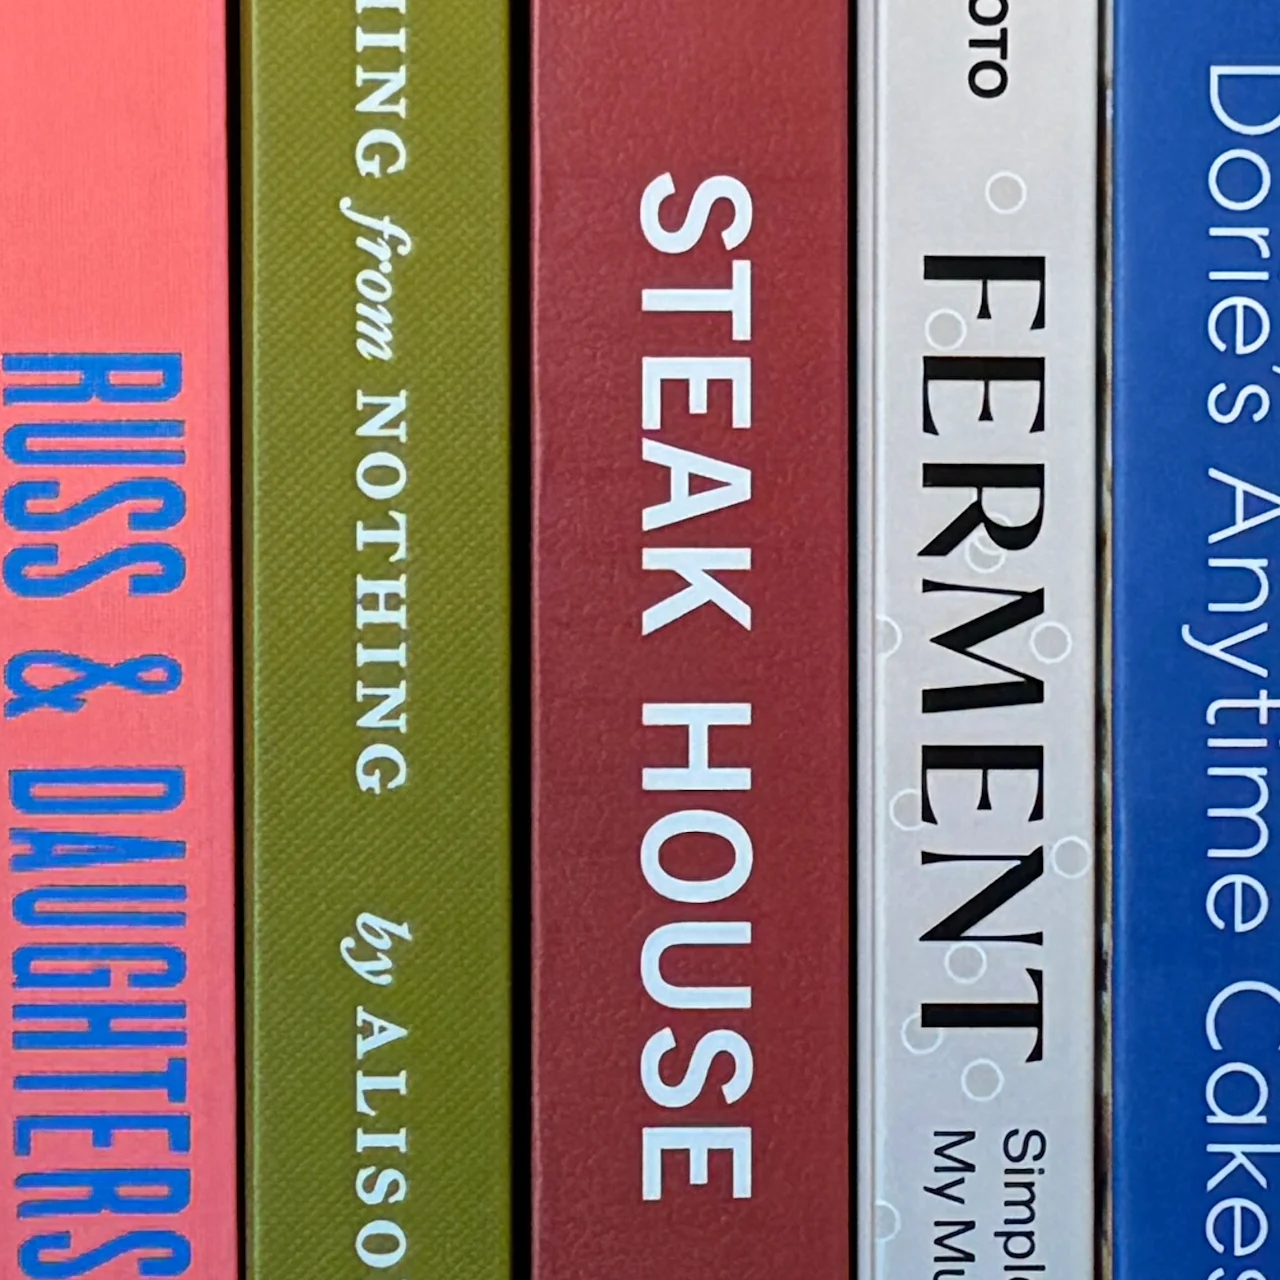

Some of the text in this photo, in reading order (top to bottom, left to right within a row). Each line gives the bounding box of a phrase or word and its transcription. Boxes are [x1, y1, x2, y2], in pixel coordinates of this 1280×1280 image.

[340, 199, 411, 363] from
[353, 388, 409, 797] NOTHING
[639, 171, 754, 1202] STEAK HOUSE
[917, 253, 1046, 1063] FERMENT
[0, 351, 192, 1280] RUSS & DAUGHTERS
[340, 913, 411, 987] by
[923, 1129, 977, 1207] My
